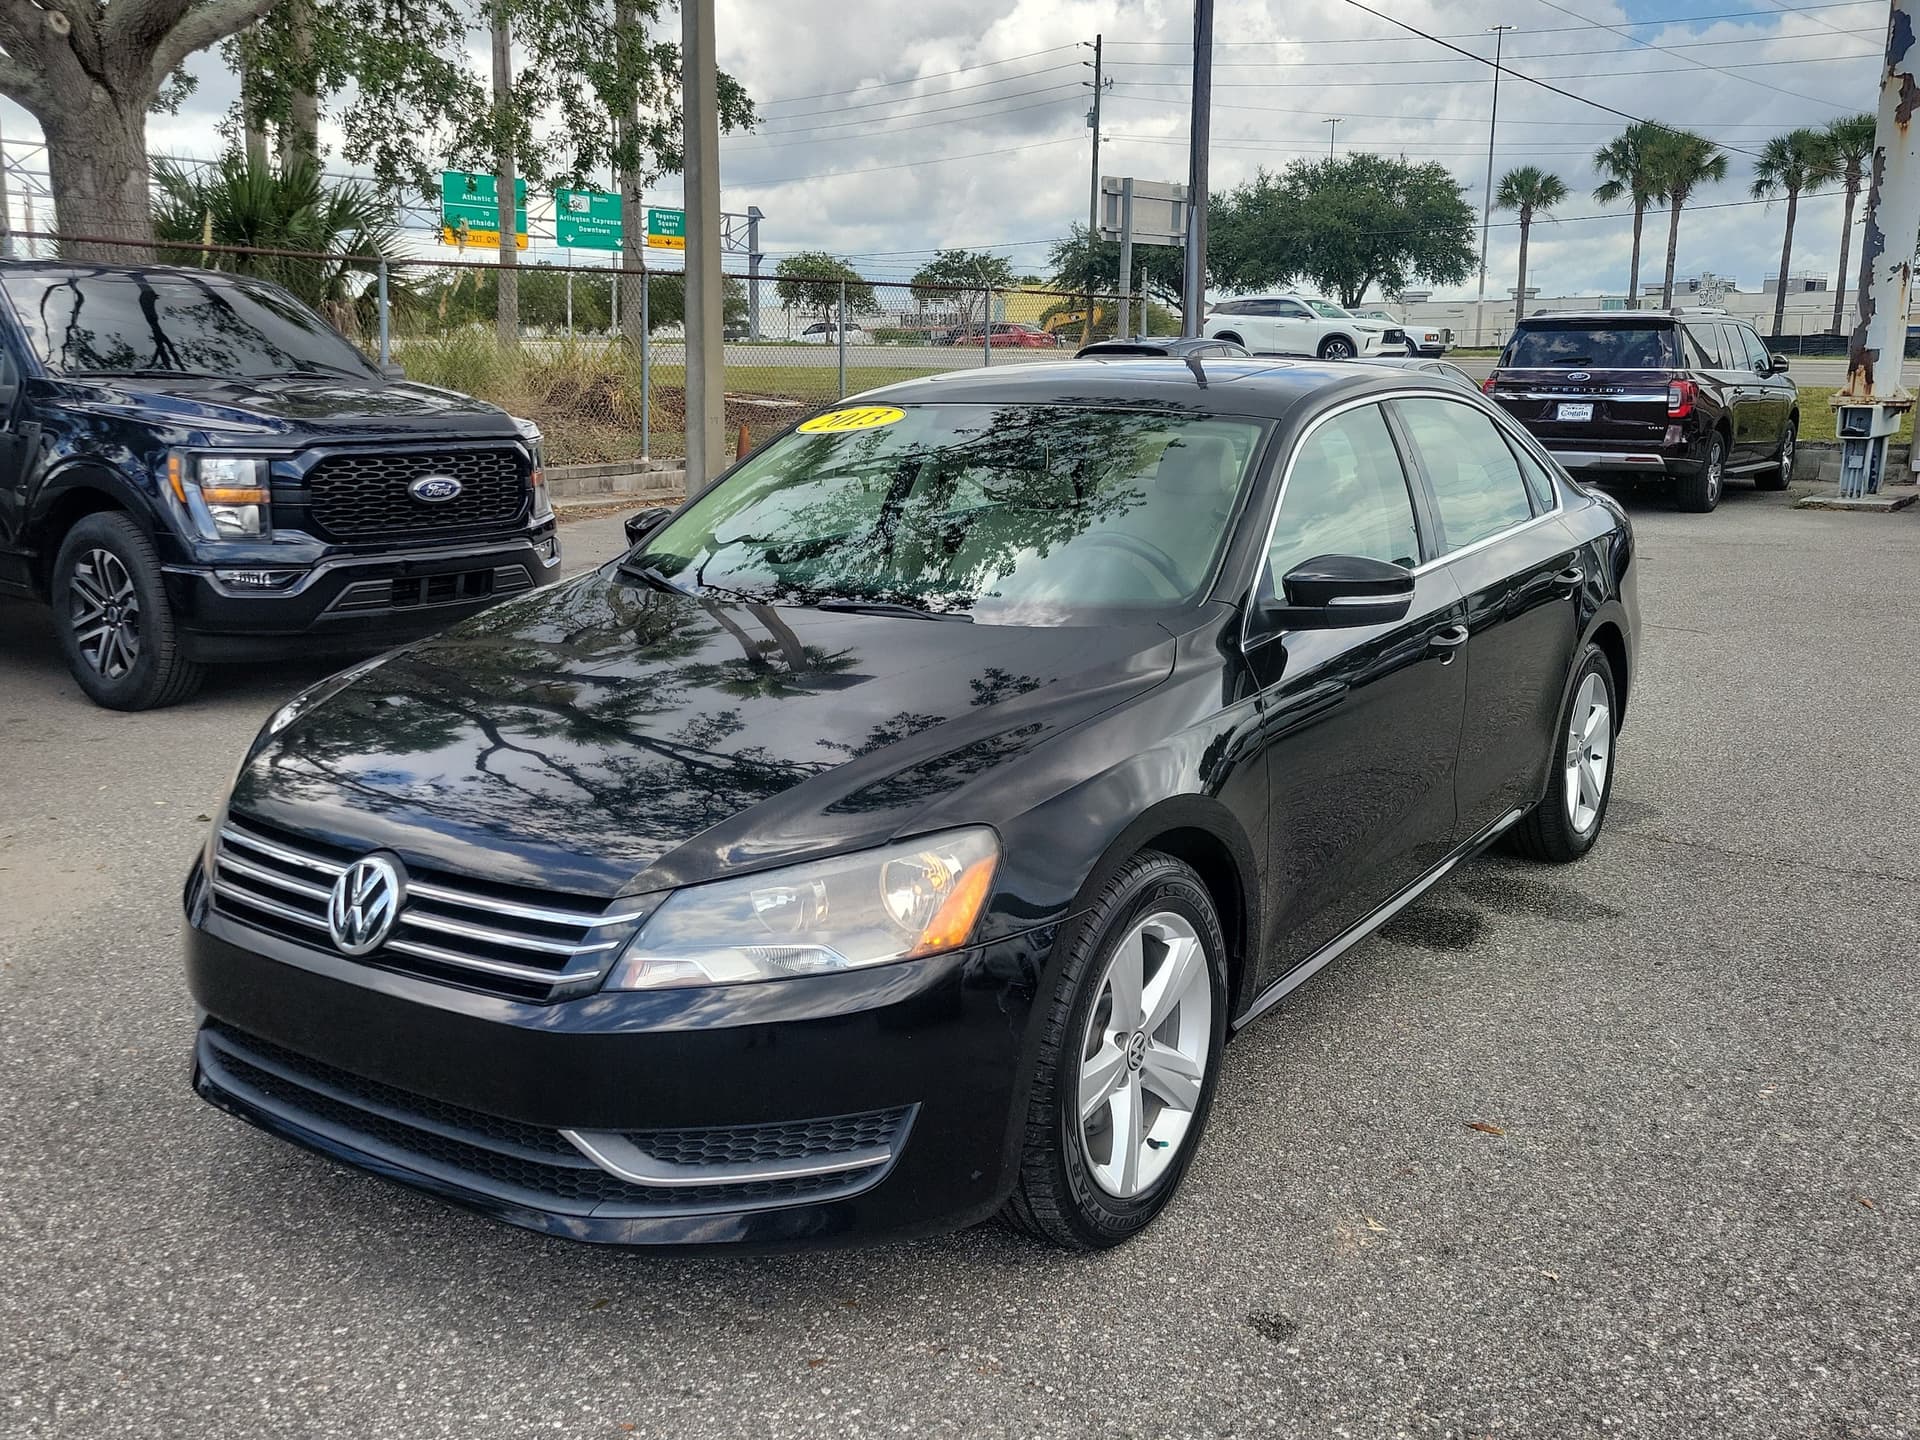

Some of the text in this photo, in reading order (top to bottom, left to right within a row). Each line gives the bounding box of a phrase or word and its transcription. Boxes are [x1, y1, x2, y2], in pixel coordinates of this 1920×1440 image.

[462, 193, 492, 203] Atlantic
[560, 215, 622, 226] Arlington Expressw
[655, 213, 680, 222] Regency
[465, 218, 495, 228] uthside
[657, 220, 679, 228] Square
[579, 225, 610, 235] Downtown
[1560, 409, 1589, 417] Coggin
[807, 410, 893, 430] 2013
[426, 482, 452, 496] Ford
